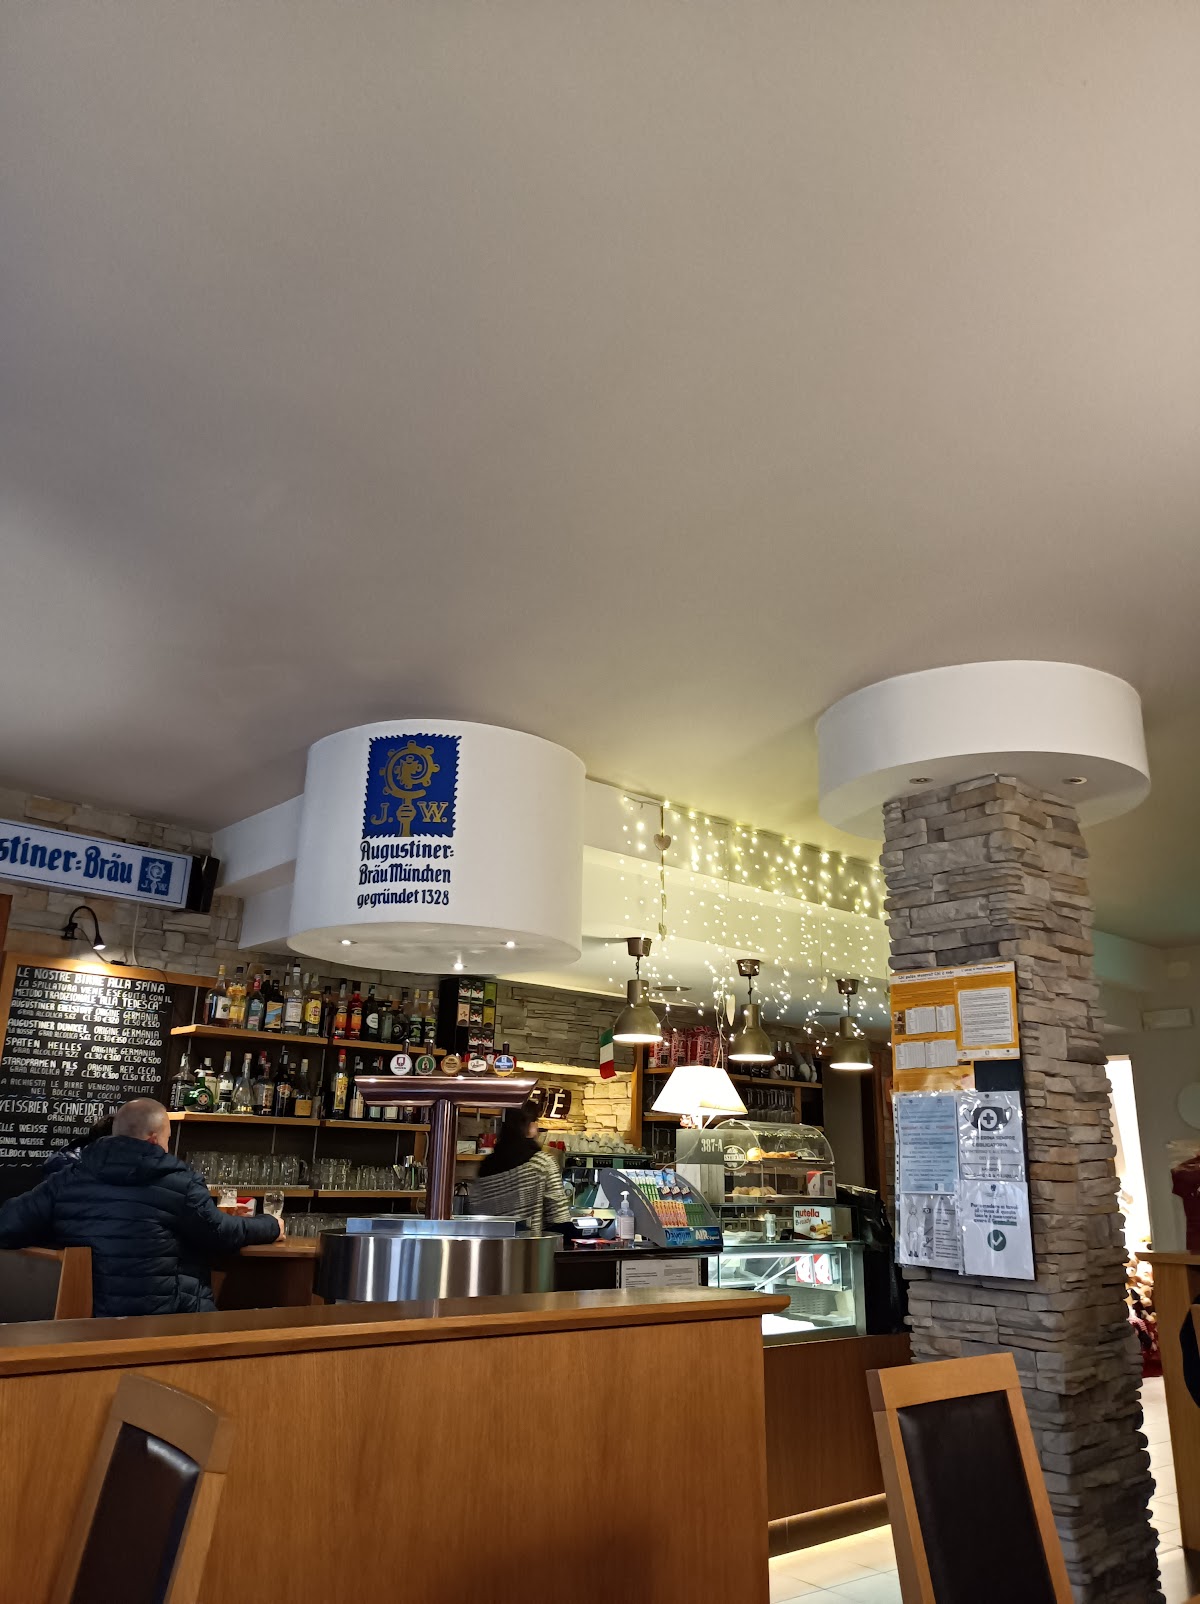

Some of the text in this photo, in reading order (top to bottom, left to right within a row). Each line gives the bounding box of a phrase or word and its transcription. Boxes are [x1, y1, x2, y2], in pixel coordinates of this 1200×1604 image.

[358, 862, 451, 885] Bräu München
[357, 888, 450, 909] gegründet 1328
[17, 968, 30, 977] LE
[34, 968, 71, 982] NOSTRE
[107, 978, 131, 989] ALLA
[135, 981, 165, 993] SPINA
[15, 988, 43, 998] METODO
[100, 996, 118, 1006] ALLA
[32, 981, 77, 992] SPILLATURA
[106, 989, 146, 1000] ESEGUITA
[149, 994, 163, 1002] CON
[11, 1000, 55, 1010] AUGUSTINER
[95, 1008, 119, 1018] ORIGINE
[123, 1010, 158, 1021] GERMANIA
[8, 1018, 159, 1039] AUGUSTINER DUNKEL ORIGINE GERMANIA
[5, 1037, 156, 1057] SPATEN HELLES ORIGINE GERMANIA
[32, 1049, 63, 1057] ALCOLICA
[2, 1057, 56, 1068] STAROPRAMEN
[61, 1061, 78, 1070] PILS
[87, 1063, 114, 1073] ORIGINE
[137, 1066, 156, 1075] CECA
[30, 1067, 60, 1075] ALCOLICA
[10, 1078, 46, 1087] RICHIESTA
[64, 1080, 84, 1089] BIRRE
[88, 1082, 120, 1090] VENGONO
[123, 1085, 155, 1094] SPILLATE
[31, 1087, 46, 1095] NEL
[52, 1088, 80, 1098] BOCCALE
[53, 1102, 104, 1116] SCHNEIDER
[47, 1114, 77, 1123] ORIGINE
[19, 1124, 48, 1134] WEISSE
[19, 1137, 45, 1146] WEISSE
[795, 1208, 820, 1218] nutella
